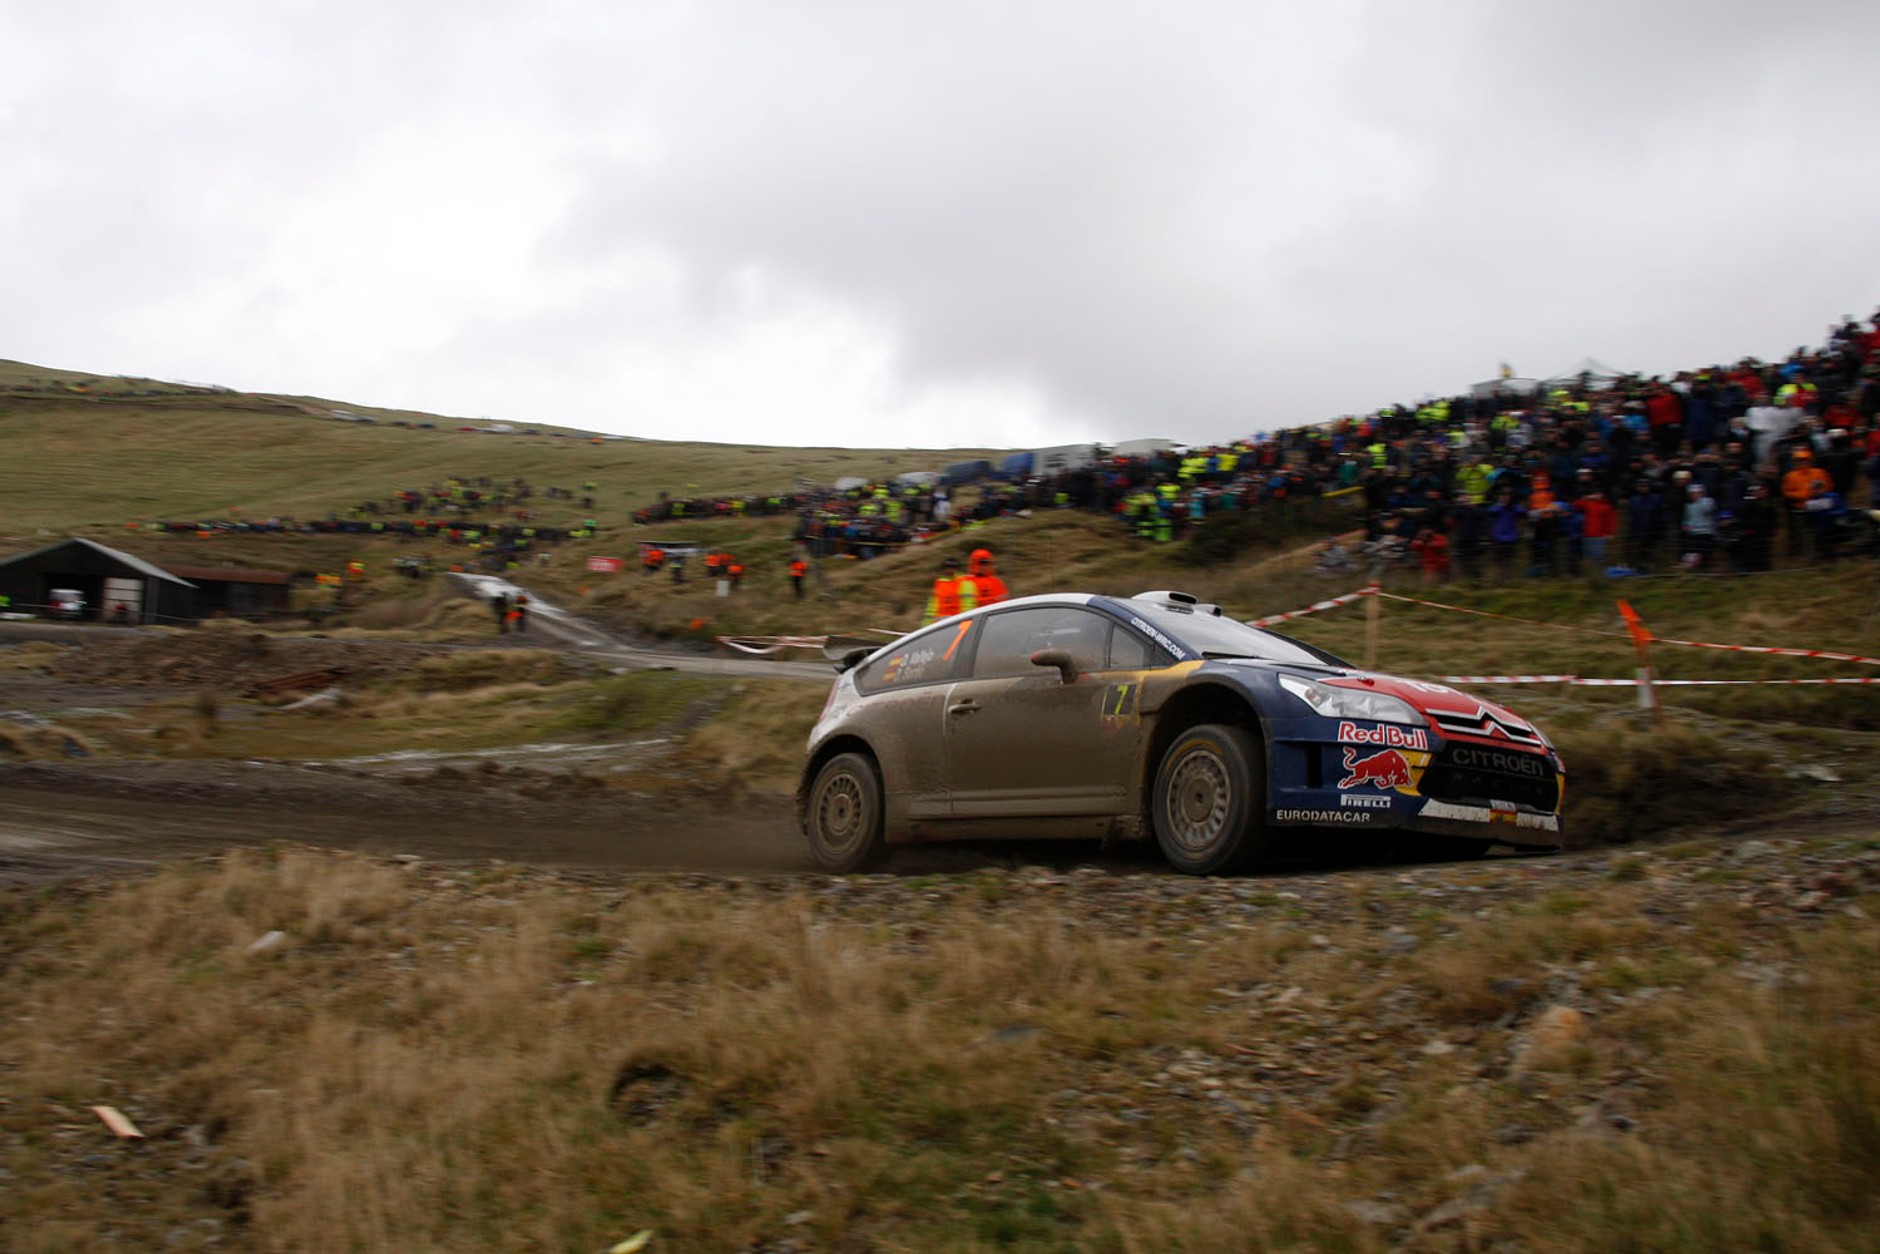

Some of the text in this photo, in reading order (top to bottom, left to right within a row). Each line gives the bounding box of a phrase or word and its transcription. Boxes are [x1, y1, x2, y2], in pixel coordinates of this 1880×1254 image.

[1115, 684, 1129, 715] 7
[1338, 721, 1428, 751] Red Bull
[1340, 794, 1391, 808] PIRELLI
[1276, 809, 1371, 822] EURODATACAR
